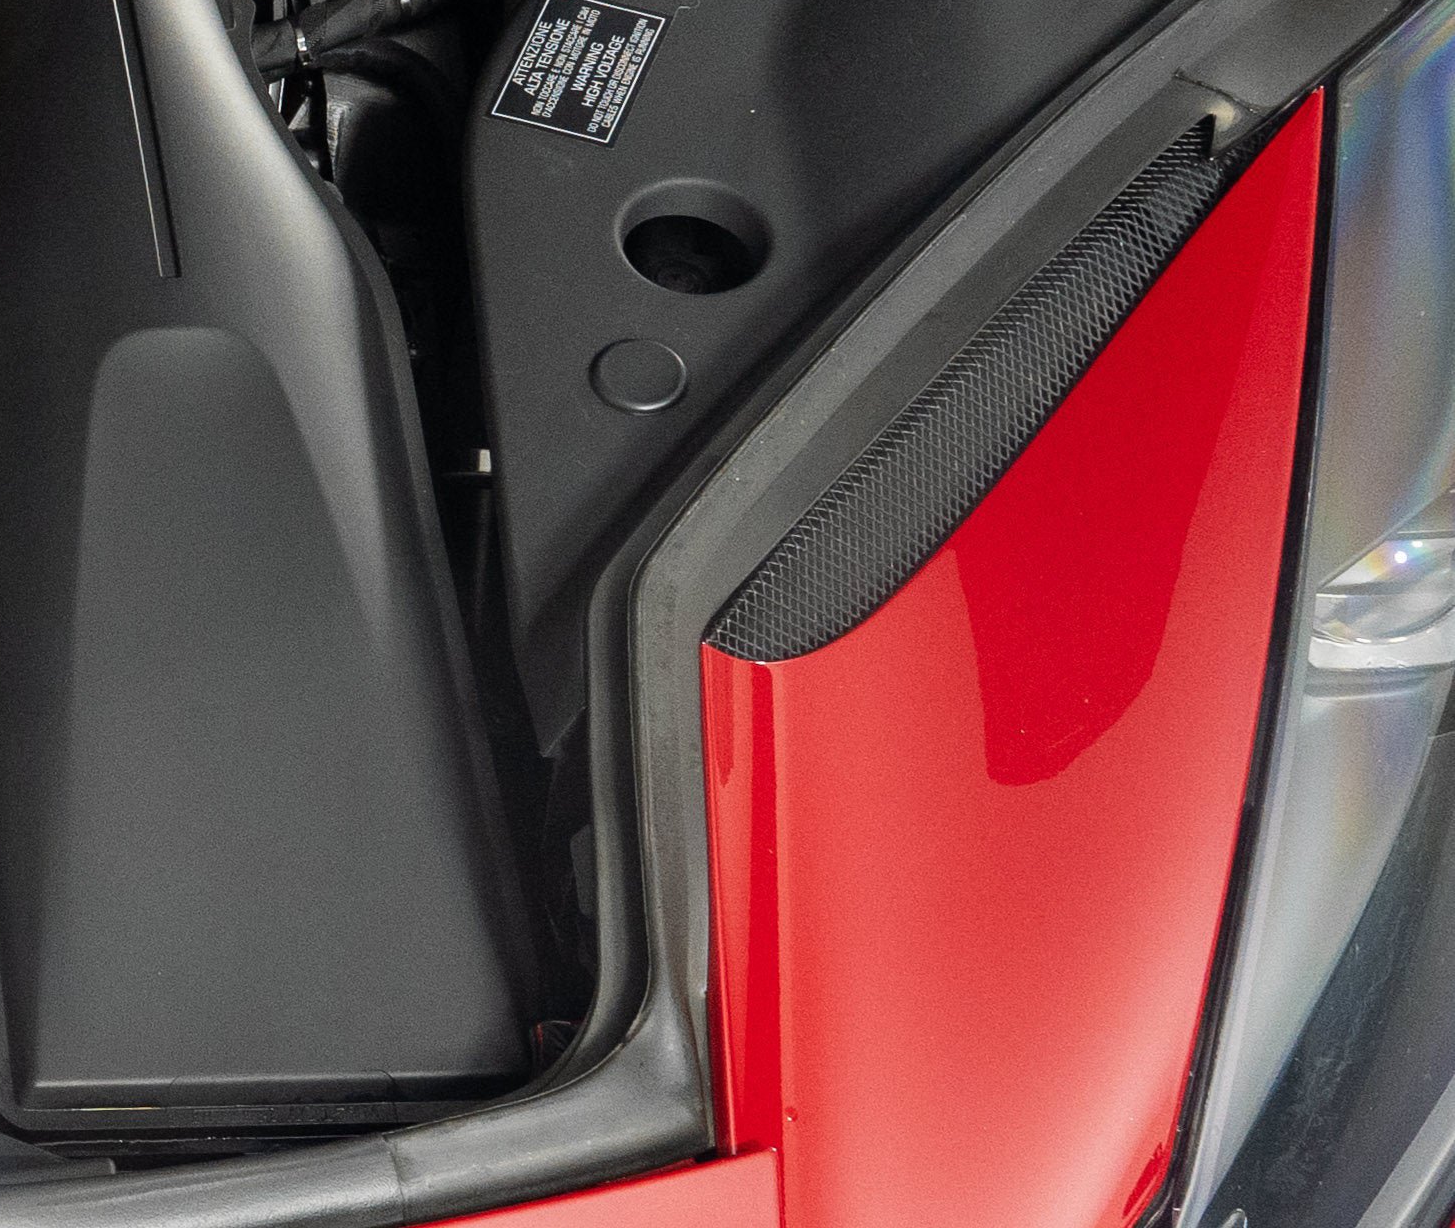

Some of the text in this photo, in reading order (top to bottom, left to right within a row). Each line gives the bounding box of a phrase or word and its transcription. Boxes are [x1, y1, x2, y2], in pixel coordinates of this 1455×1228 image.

[512, 21, 552, 85] ATTENZIONE
[523, 17, 570, 96] ALTA TENSIONE
[570, 41, 604, 91] WARNING
[581, 34, 625, 107] HIGH VOLTAGE
